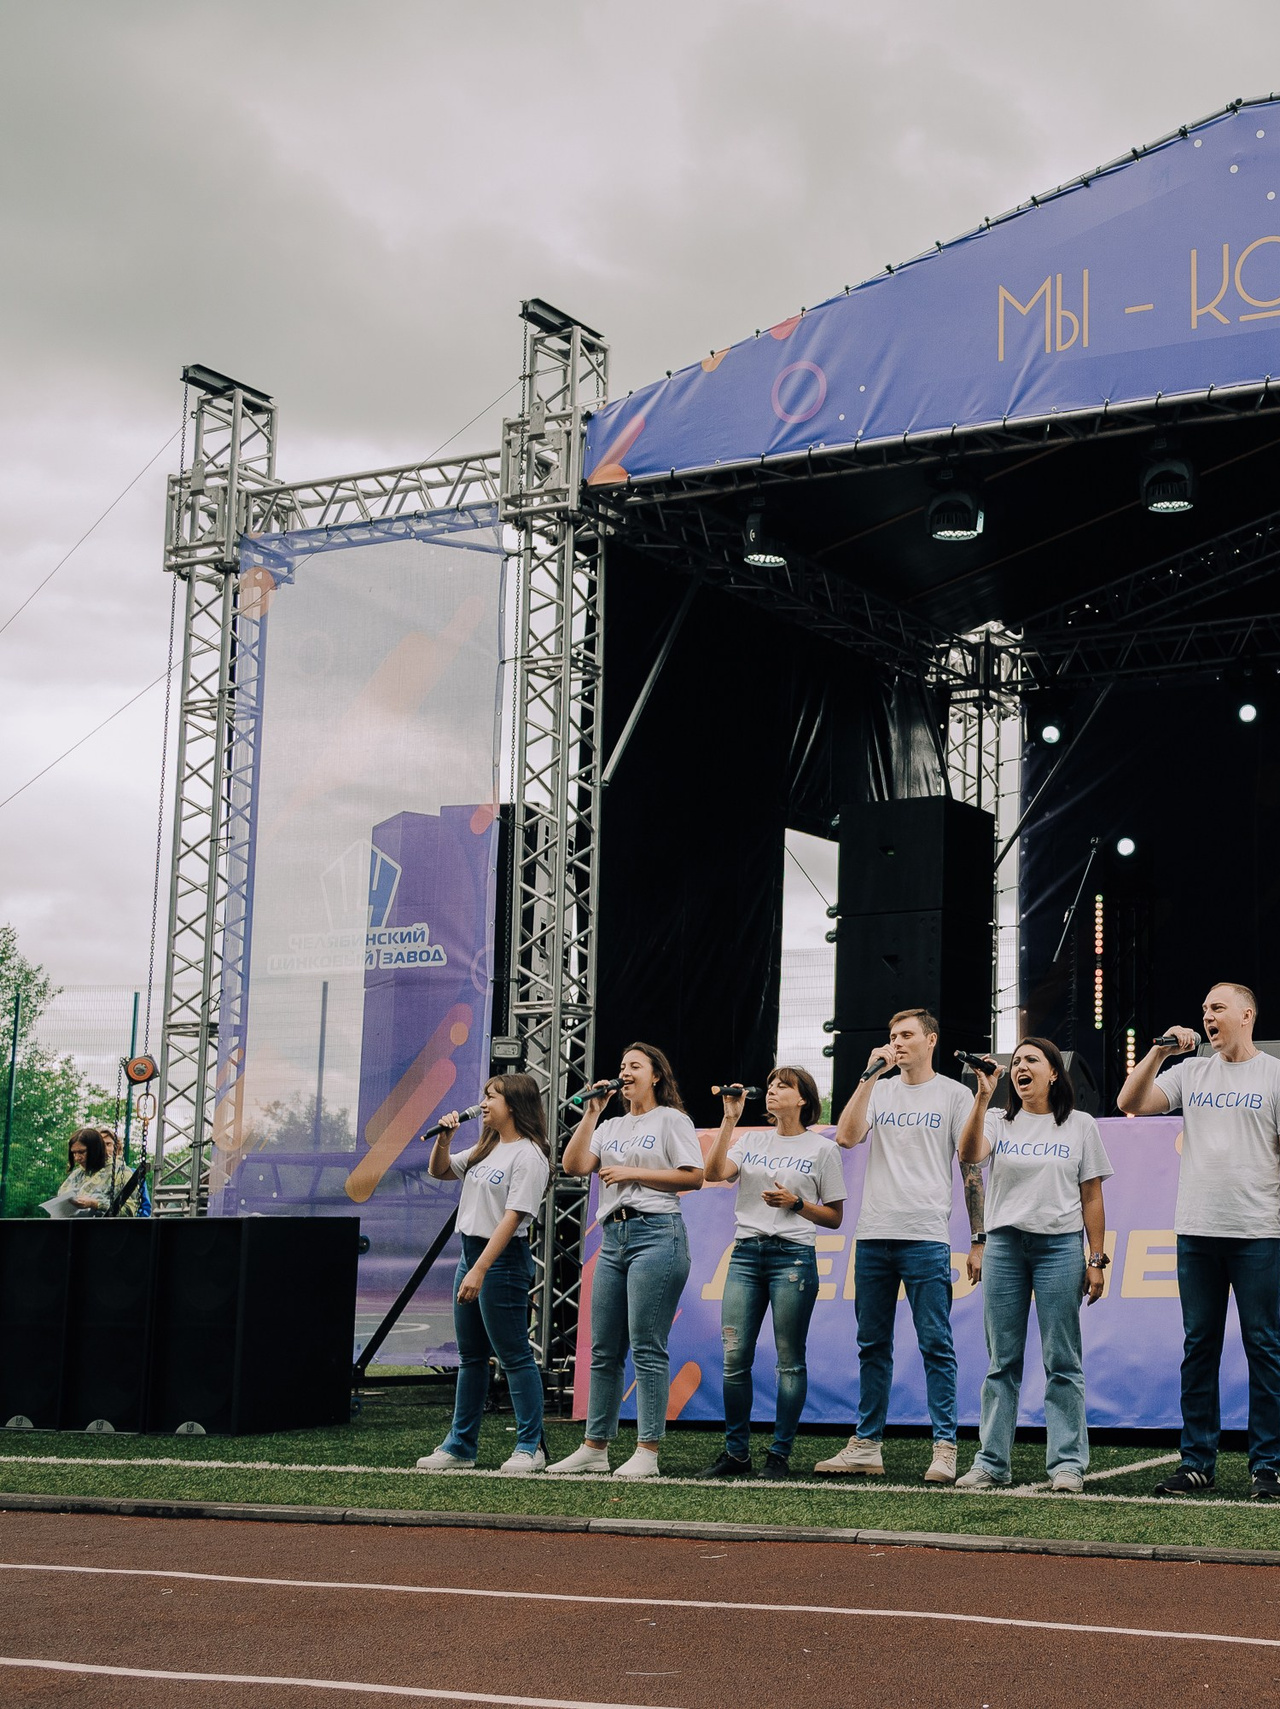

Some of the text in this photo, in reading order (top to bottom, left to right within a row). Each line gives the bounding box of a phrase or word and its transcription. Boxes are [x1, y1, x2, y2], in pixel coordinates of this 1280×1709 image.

[998, 268, 1089, 361] МЫ
[382, 948, 444, 966] ЗАВОД
[1188, 1091, 1263, 1110] МАССИВ
[873, 1111, 942, 1129] МАССИВ
[995, 1139, 1071, 1160] МАССИВ
[742, 1151, 813, 1175] МАССИВ
